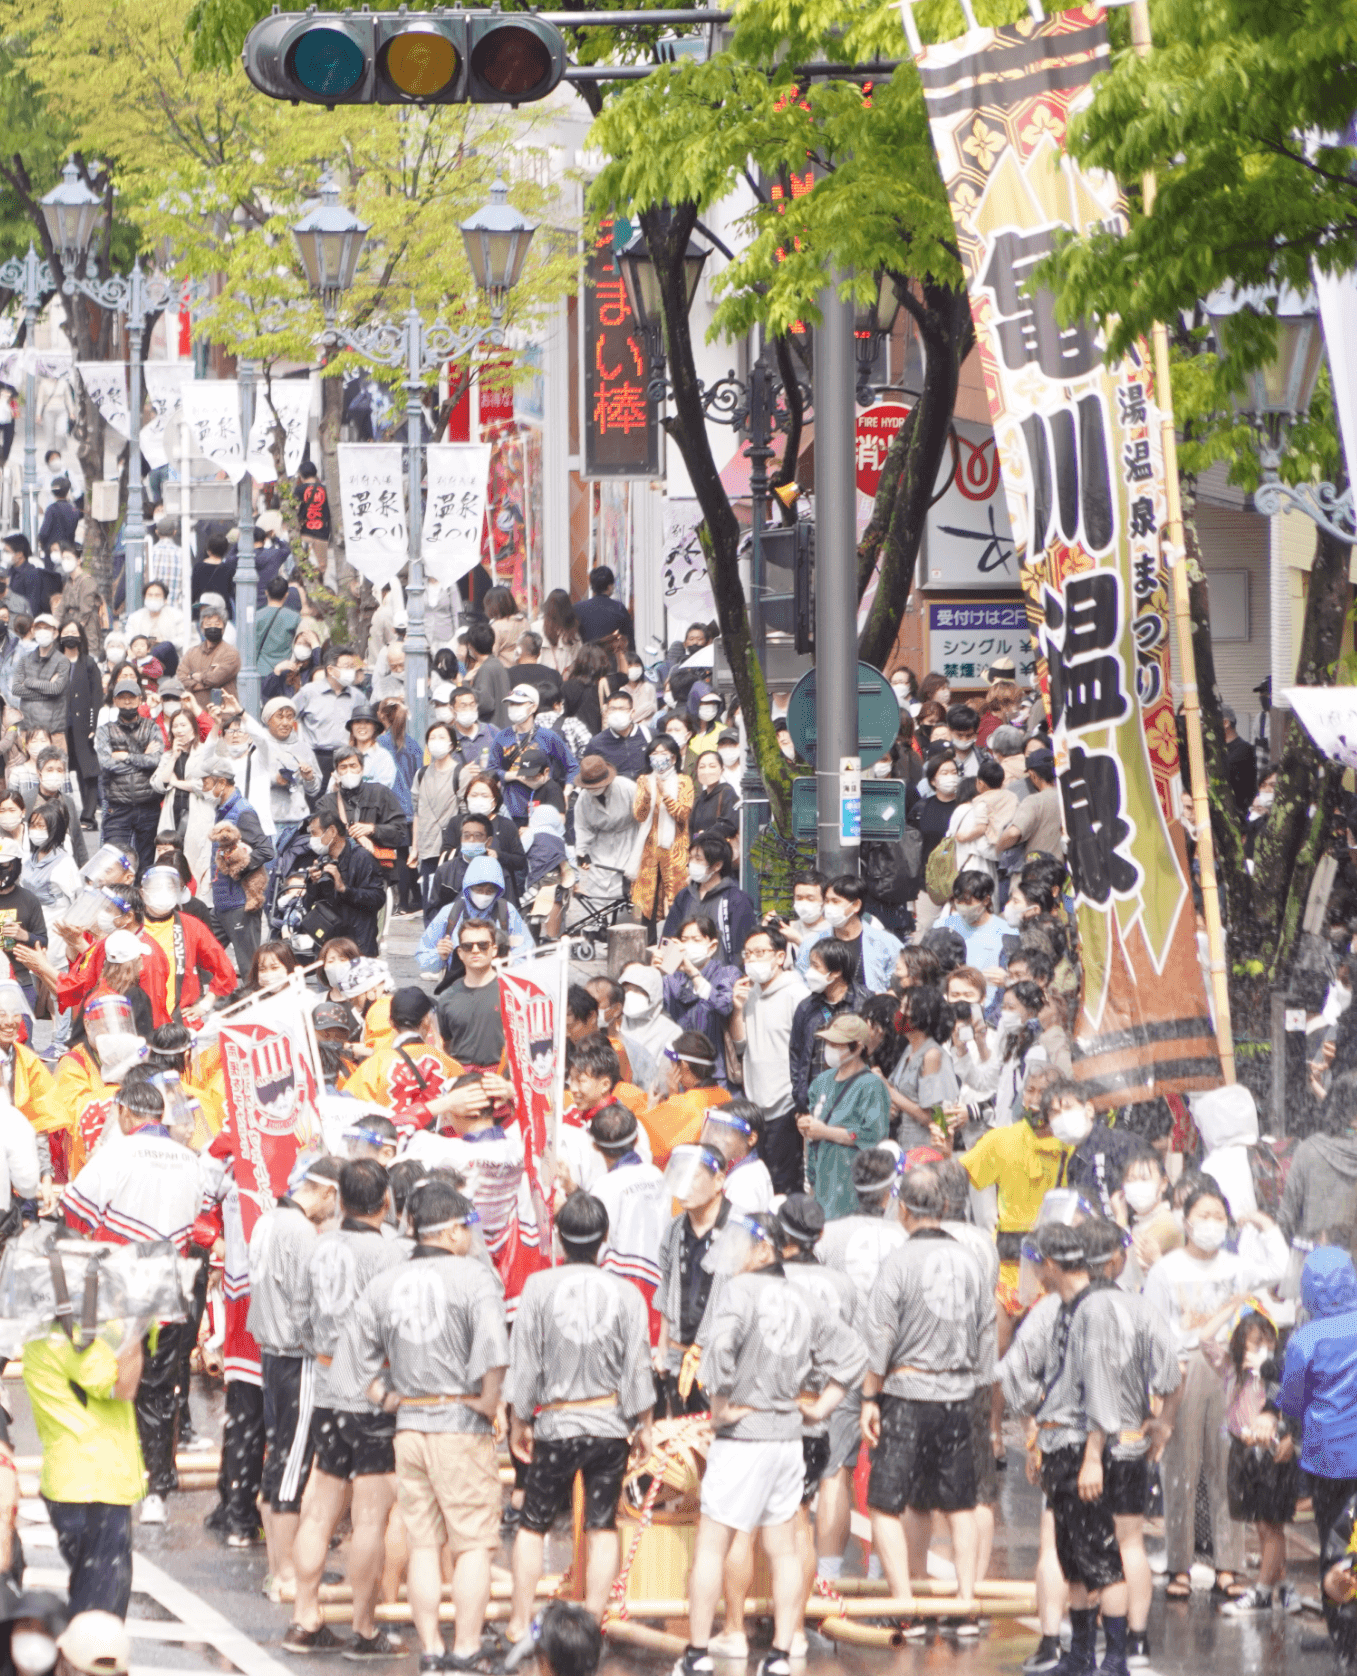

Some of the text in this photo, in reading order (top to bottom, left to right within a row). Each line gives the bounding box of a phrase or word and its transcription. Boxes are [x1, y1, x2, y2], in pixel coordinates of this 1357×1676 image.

[858, 416, 905, 429] FIRE HYDR
[349, 489, 400, 518] 温泉
[433, 491, 480, 519] 温泉
[349, 520, 404, 542] まつり
[426, 522, 478, 543] まつり
[936, 609, 1027, 627] 受付けは2F
[943, 638, 1013, 656] シングル
